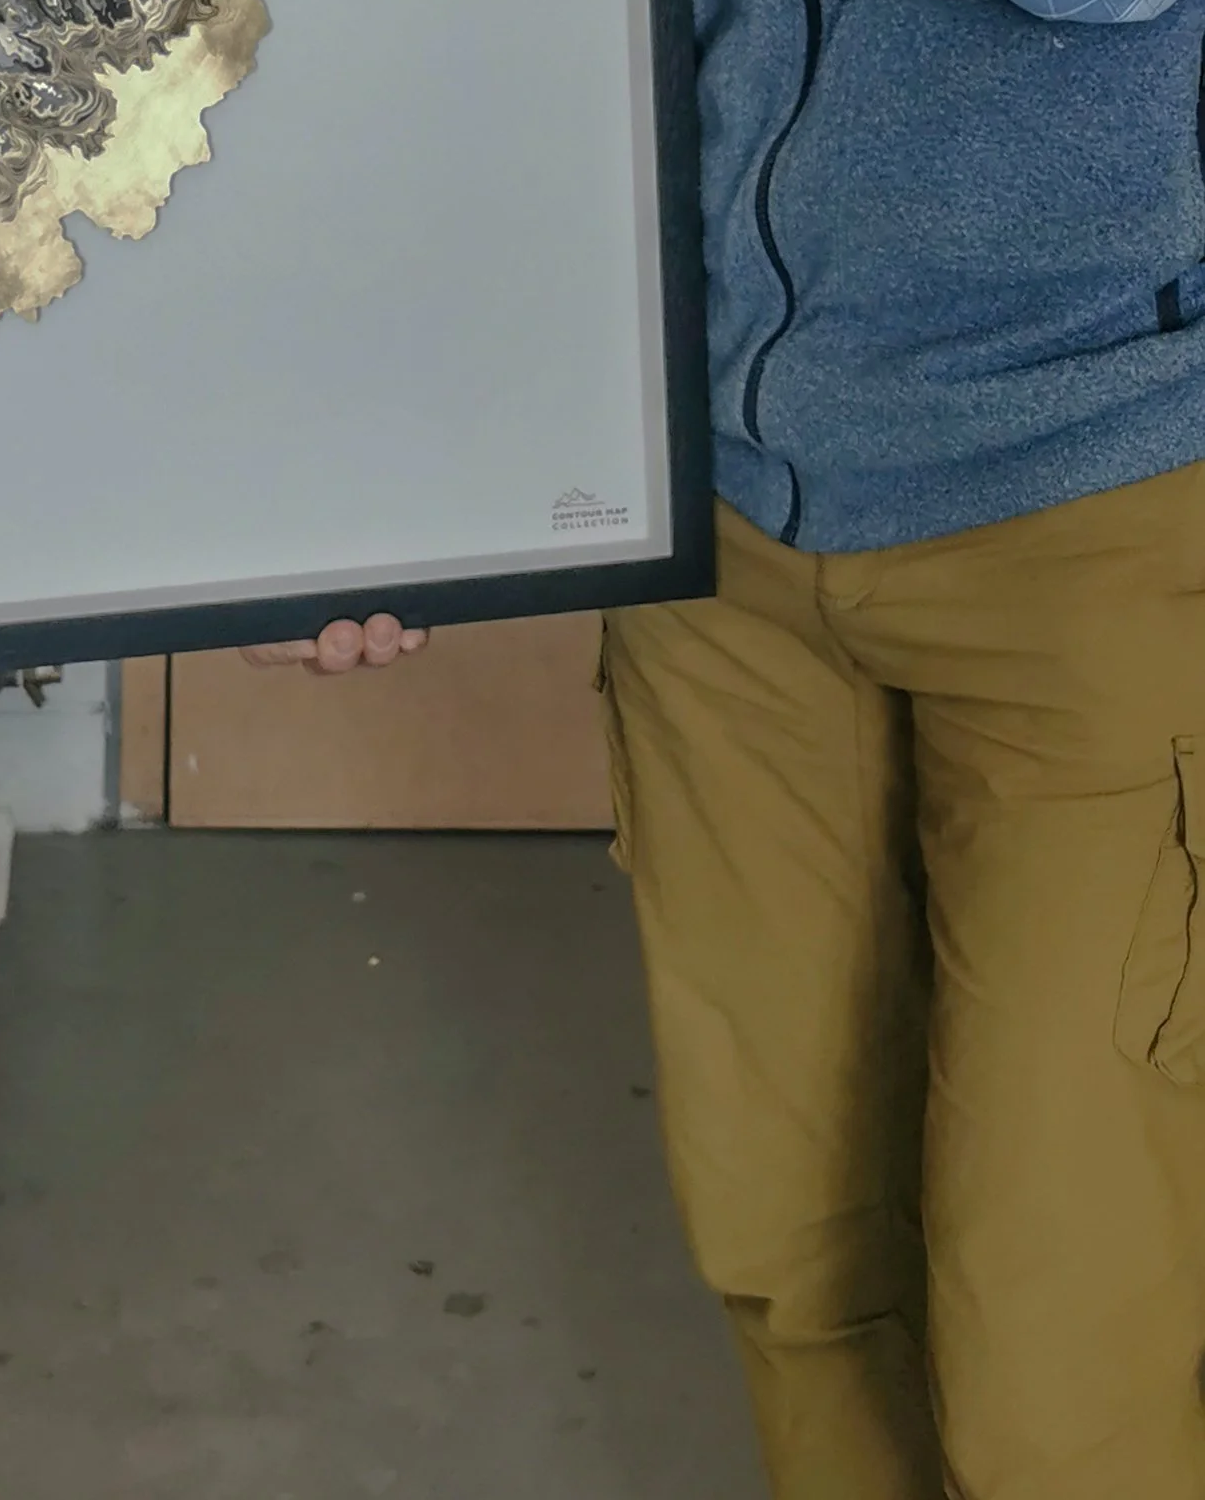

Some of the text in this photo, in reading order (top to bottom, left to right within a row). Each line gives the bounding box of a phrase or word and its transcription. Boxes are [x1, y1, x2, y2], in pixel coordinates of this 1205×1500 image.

[552, 507, 628, 520] CONTOUR MAP
[551, 517, 629, 530] COLLECTION
